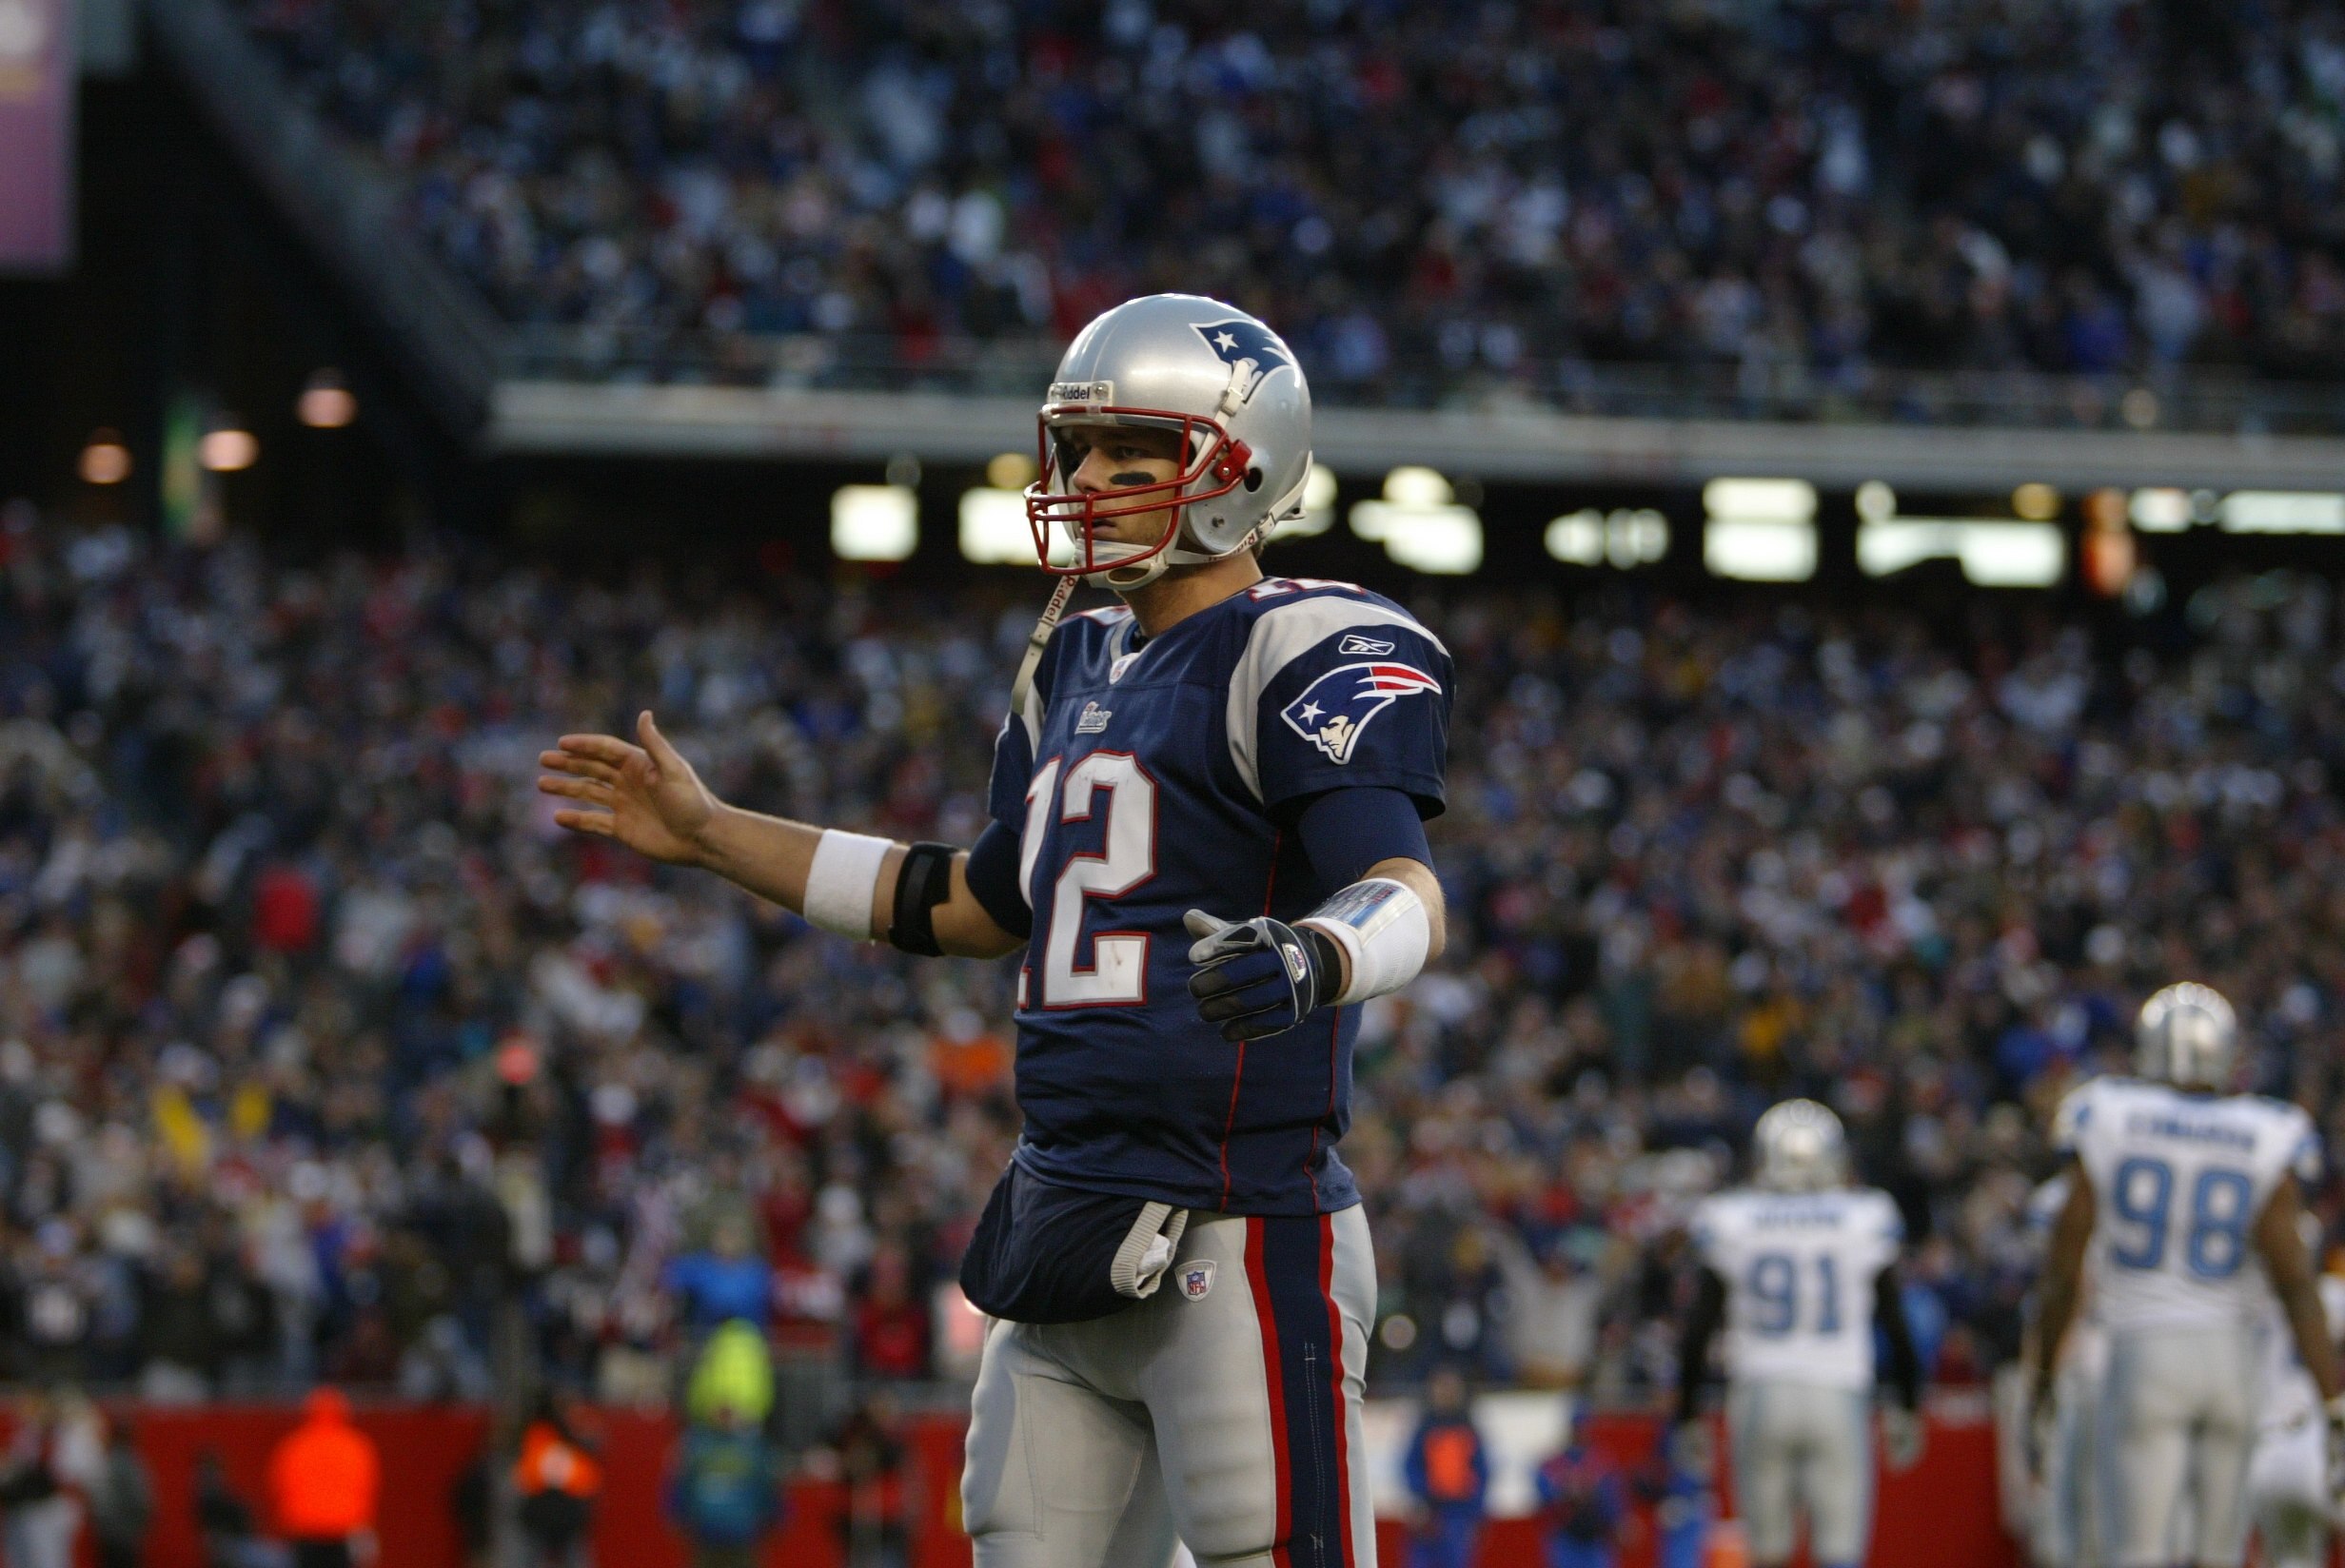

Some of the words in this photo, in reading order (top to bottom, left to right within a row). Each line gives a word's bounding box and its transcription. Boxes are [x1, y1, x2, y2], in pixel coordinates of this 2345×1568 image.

[1017, 749, 1158, 1010] 12
[2114, 1157, 2252, 1277] 98
[1748, 1254, 1841, 1337] 91
